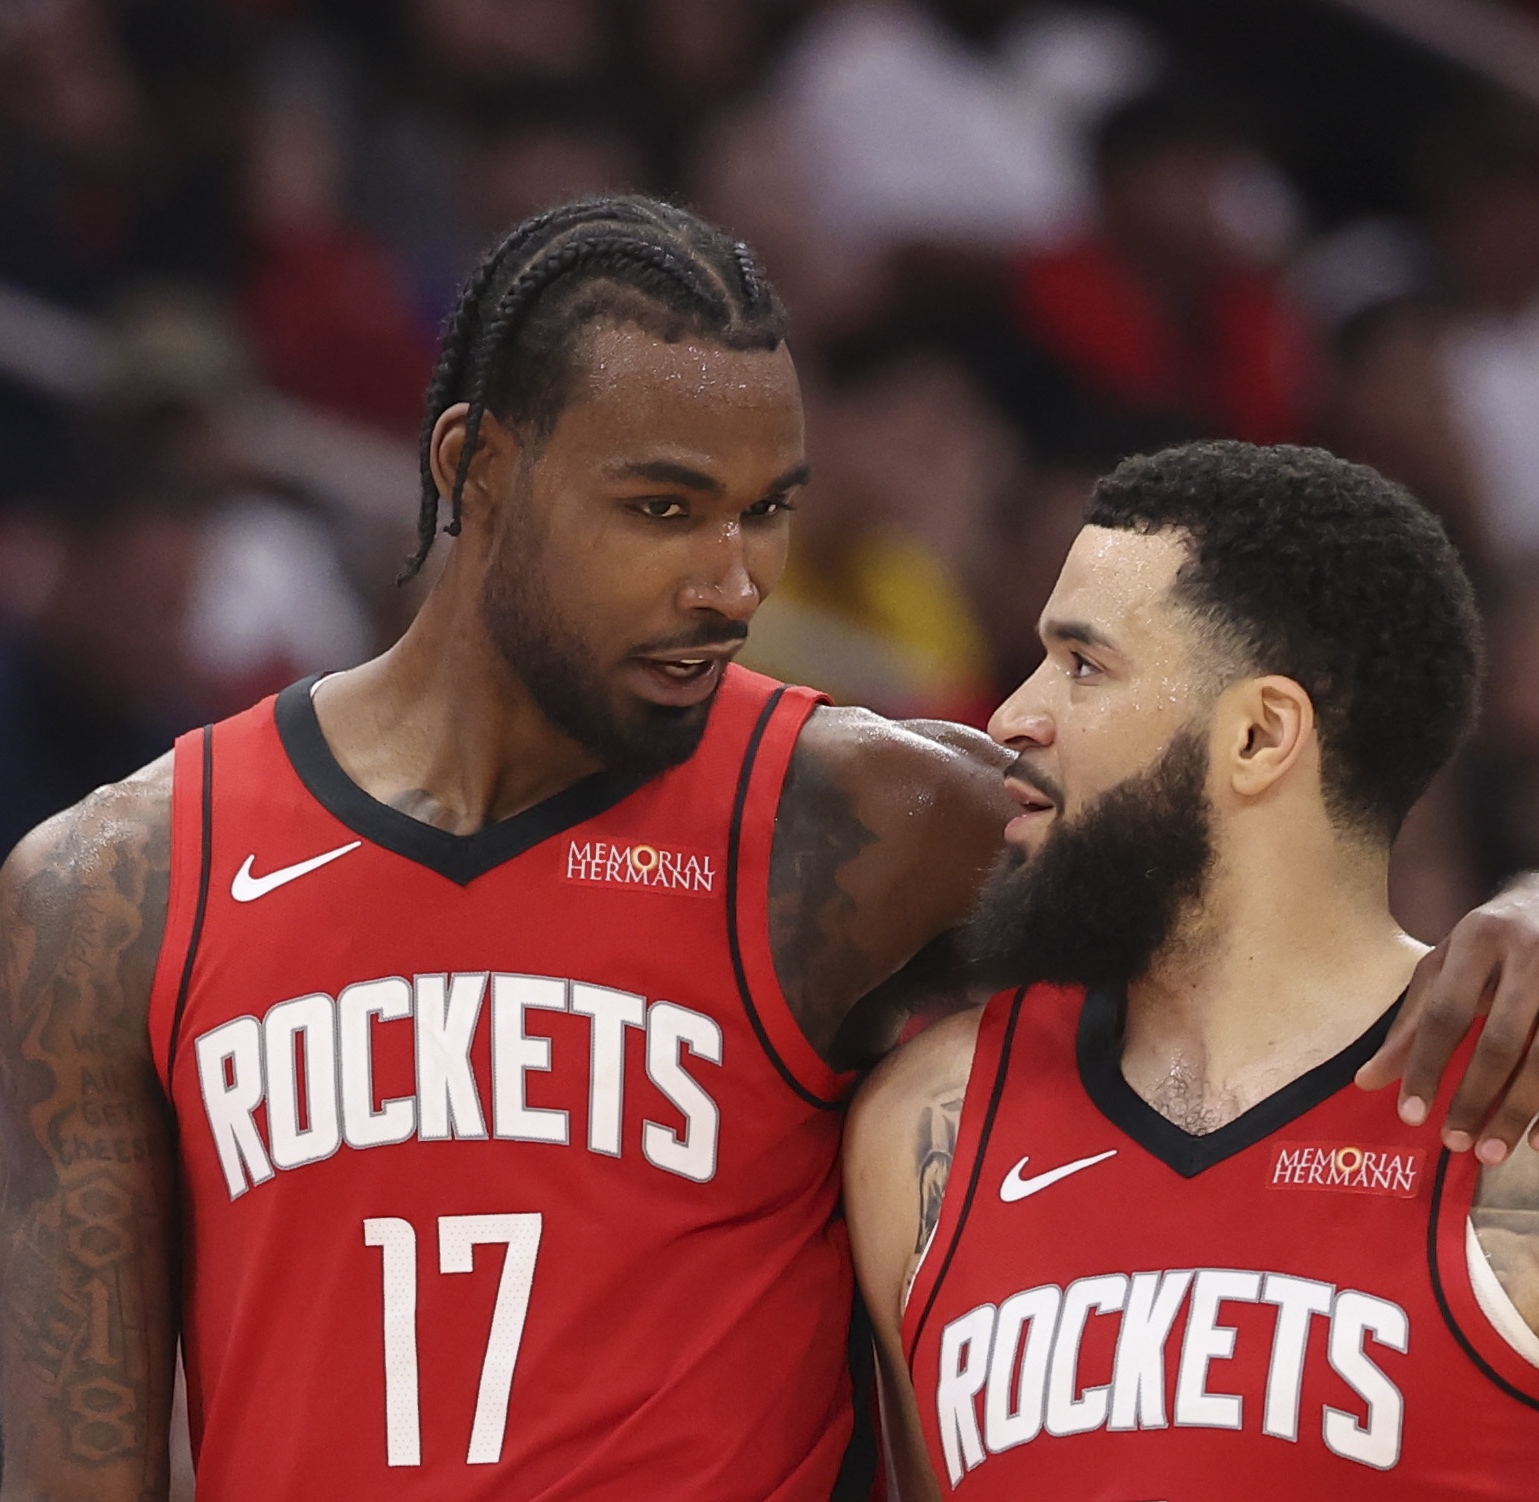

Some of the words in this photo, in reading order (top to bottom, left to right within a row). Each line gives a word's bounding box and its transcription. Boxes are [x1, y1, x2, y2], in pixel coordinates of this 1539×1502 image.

[567, 858, 714, 892] HERMANN
[568, 840, 715, 875] MEMORIAL
[194, 971, 723, 1200] ROCKETS
[1272, 1164, 1416, 1191] HERMANN
[1276, 1147, 1416, 1175] MEMORIAL
[363, 1212, 543, 1467] 17
[936, 1268, 1409, 1491] ROCKETS
